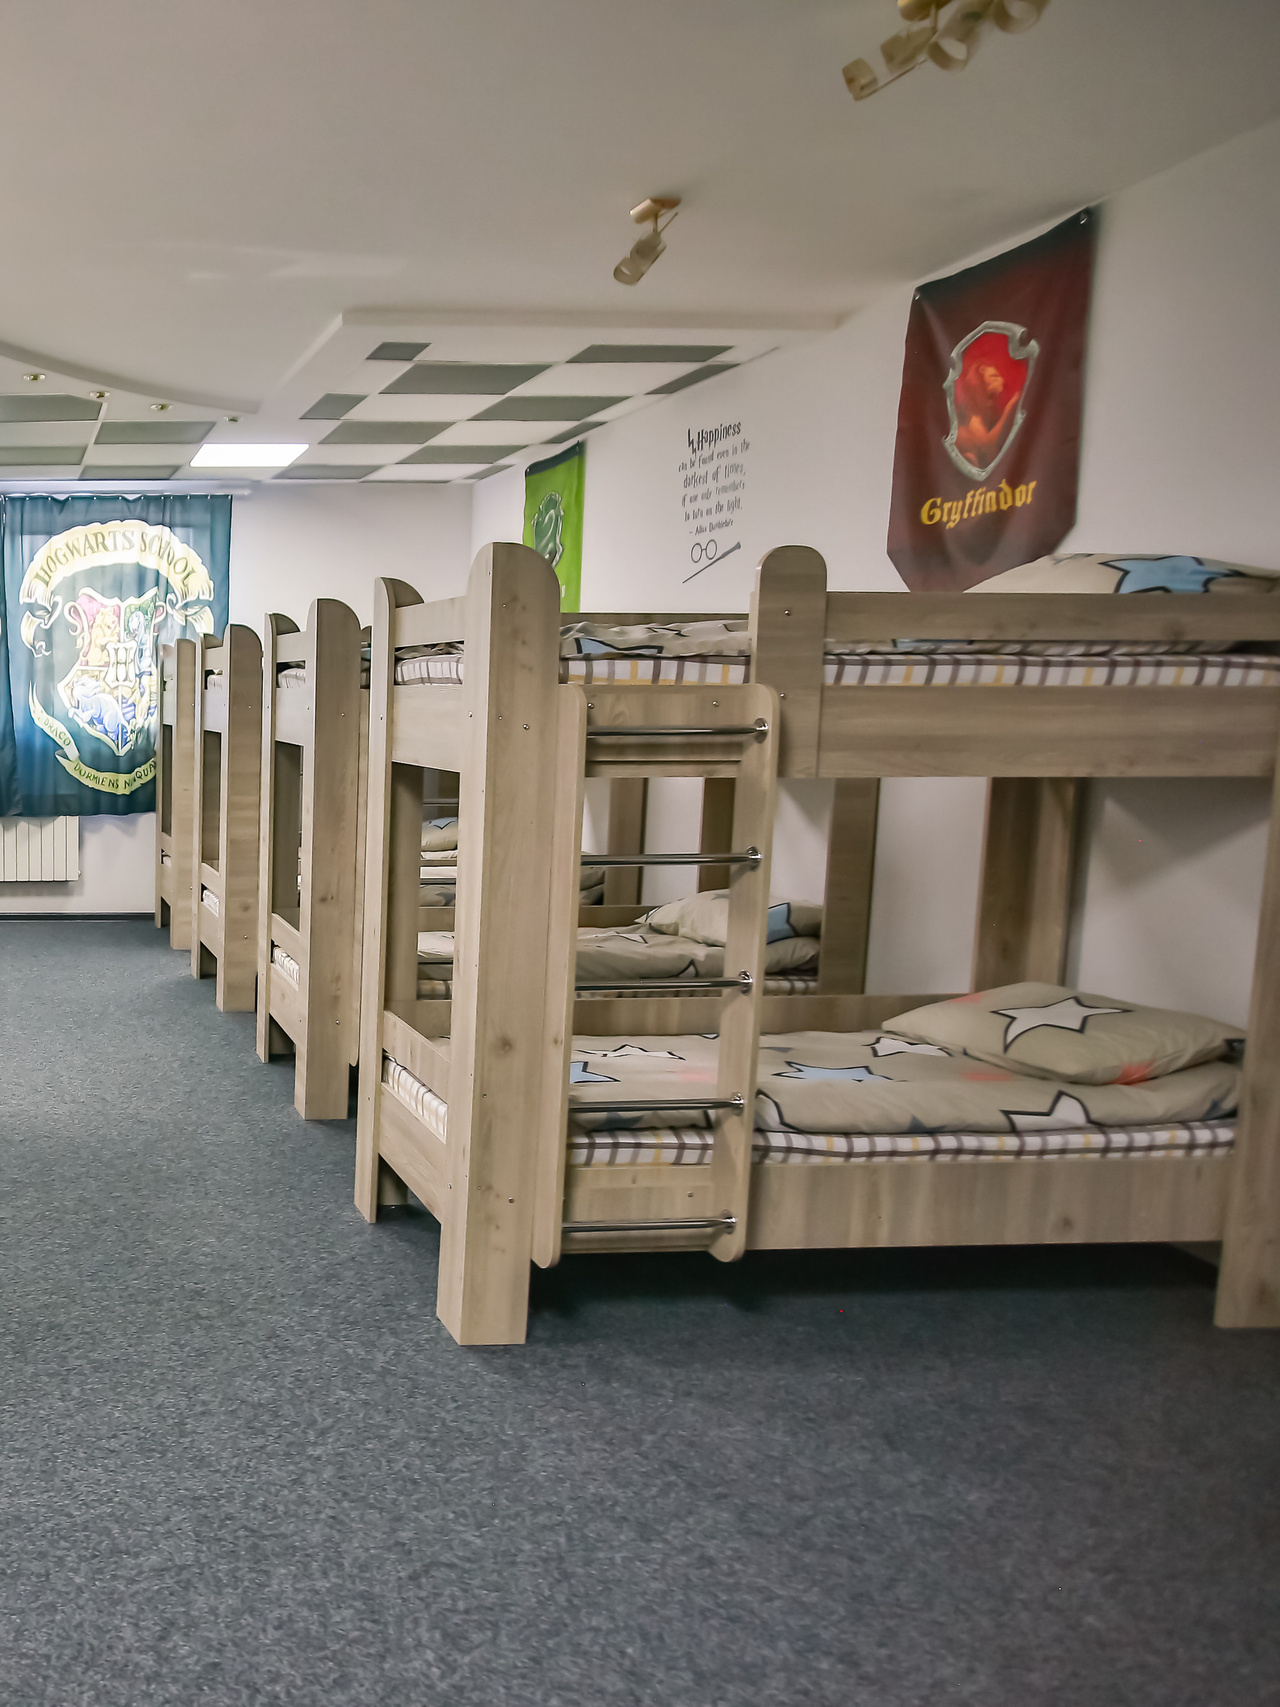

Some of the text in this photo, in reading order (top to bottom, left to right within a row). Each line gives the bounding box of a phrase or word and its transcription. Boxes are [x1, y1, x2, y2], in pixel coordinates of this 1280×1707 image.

[697, 422, 741, 451] Happiness
[920, 478, 1037, 530] Gryffindor
[34, 529, 197, 588] HOGWARTS SCHOOL
[43, 719, 72, 747] DRACO
[73, 762, 120, 789] DORMIENS
